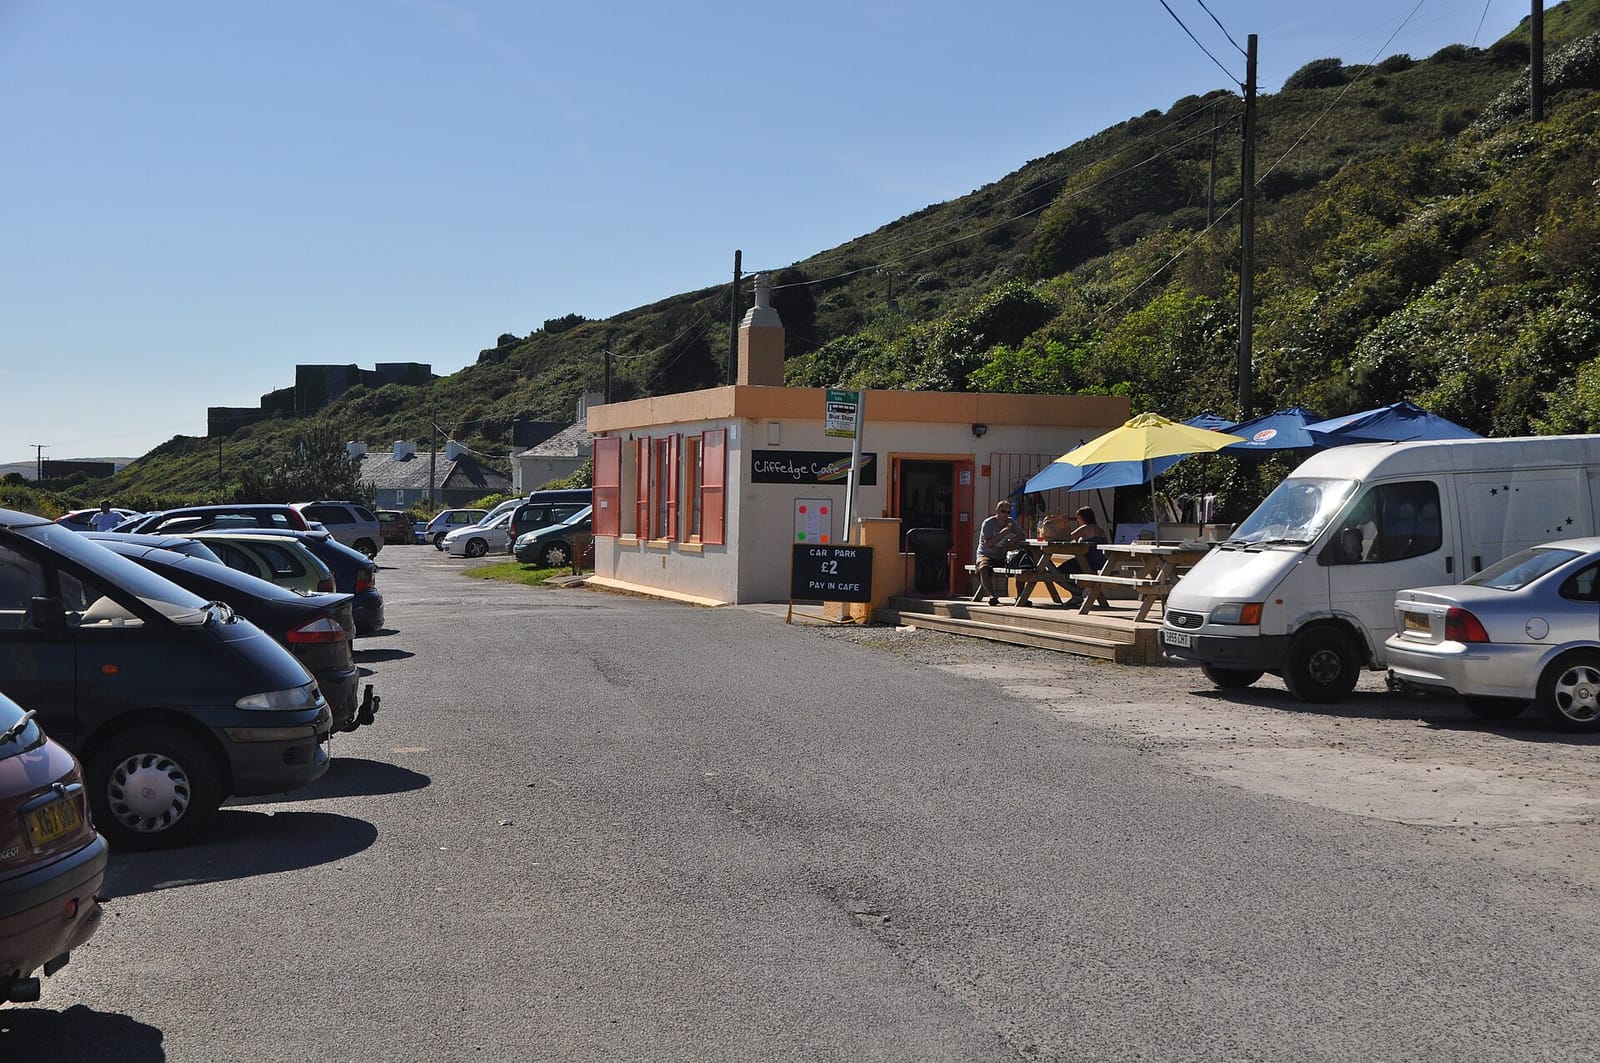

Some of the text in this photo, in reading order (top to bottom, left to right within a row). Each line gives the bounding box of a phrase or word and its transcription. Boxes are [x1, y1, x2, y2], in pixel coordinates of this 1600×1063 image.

[841, 414, 854, 422] Stop
[754, 458, 840, 480] Cliffedge Cafe
[809, 549, 856, 558] CAR PARK
[821, 560, 838, 575] £2
[809, 581, 860, 592] PAY IN CAFE
